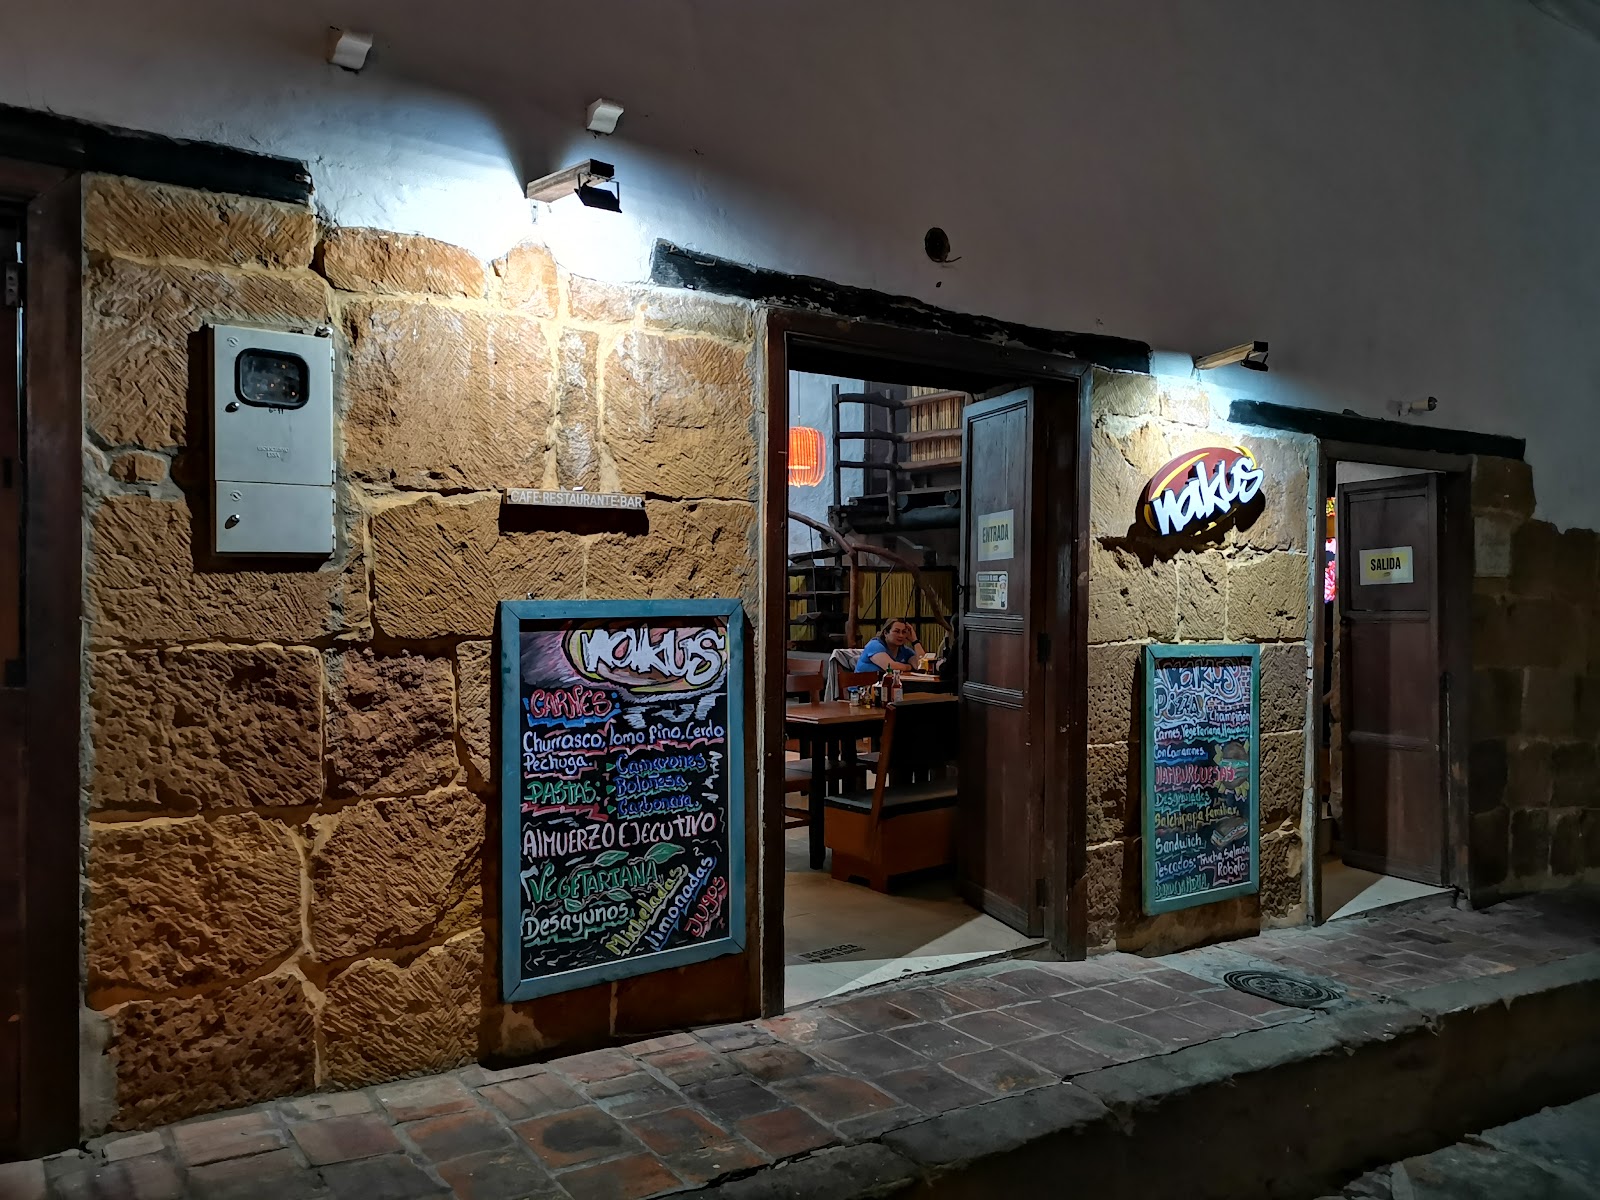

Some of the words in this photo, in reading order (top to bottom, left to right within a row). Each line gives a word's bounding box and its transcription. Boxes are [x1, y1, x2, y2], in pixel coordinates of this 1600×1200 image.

[982, 523, 1009, 543] ENTRADA
[1370, 556, 1401, 572] SALIDA
[616, 753, 706, 774] Camarones
